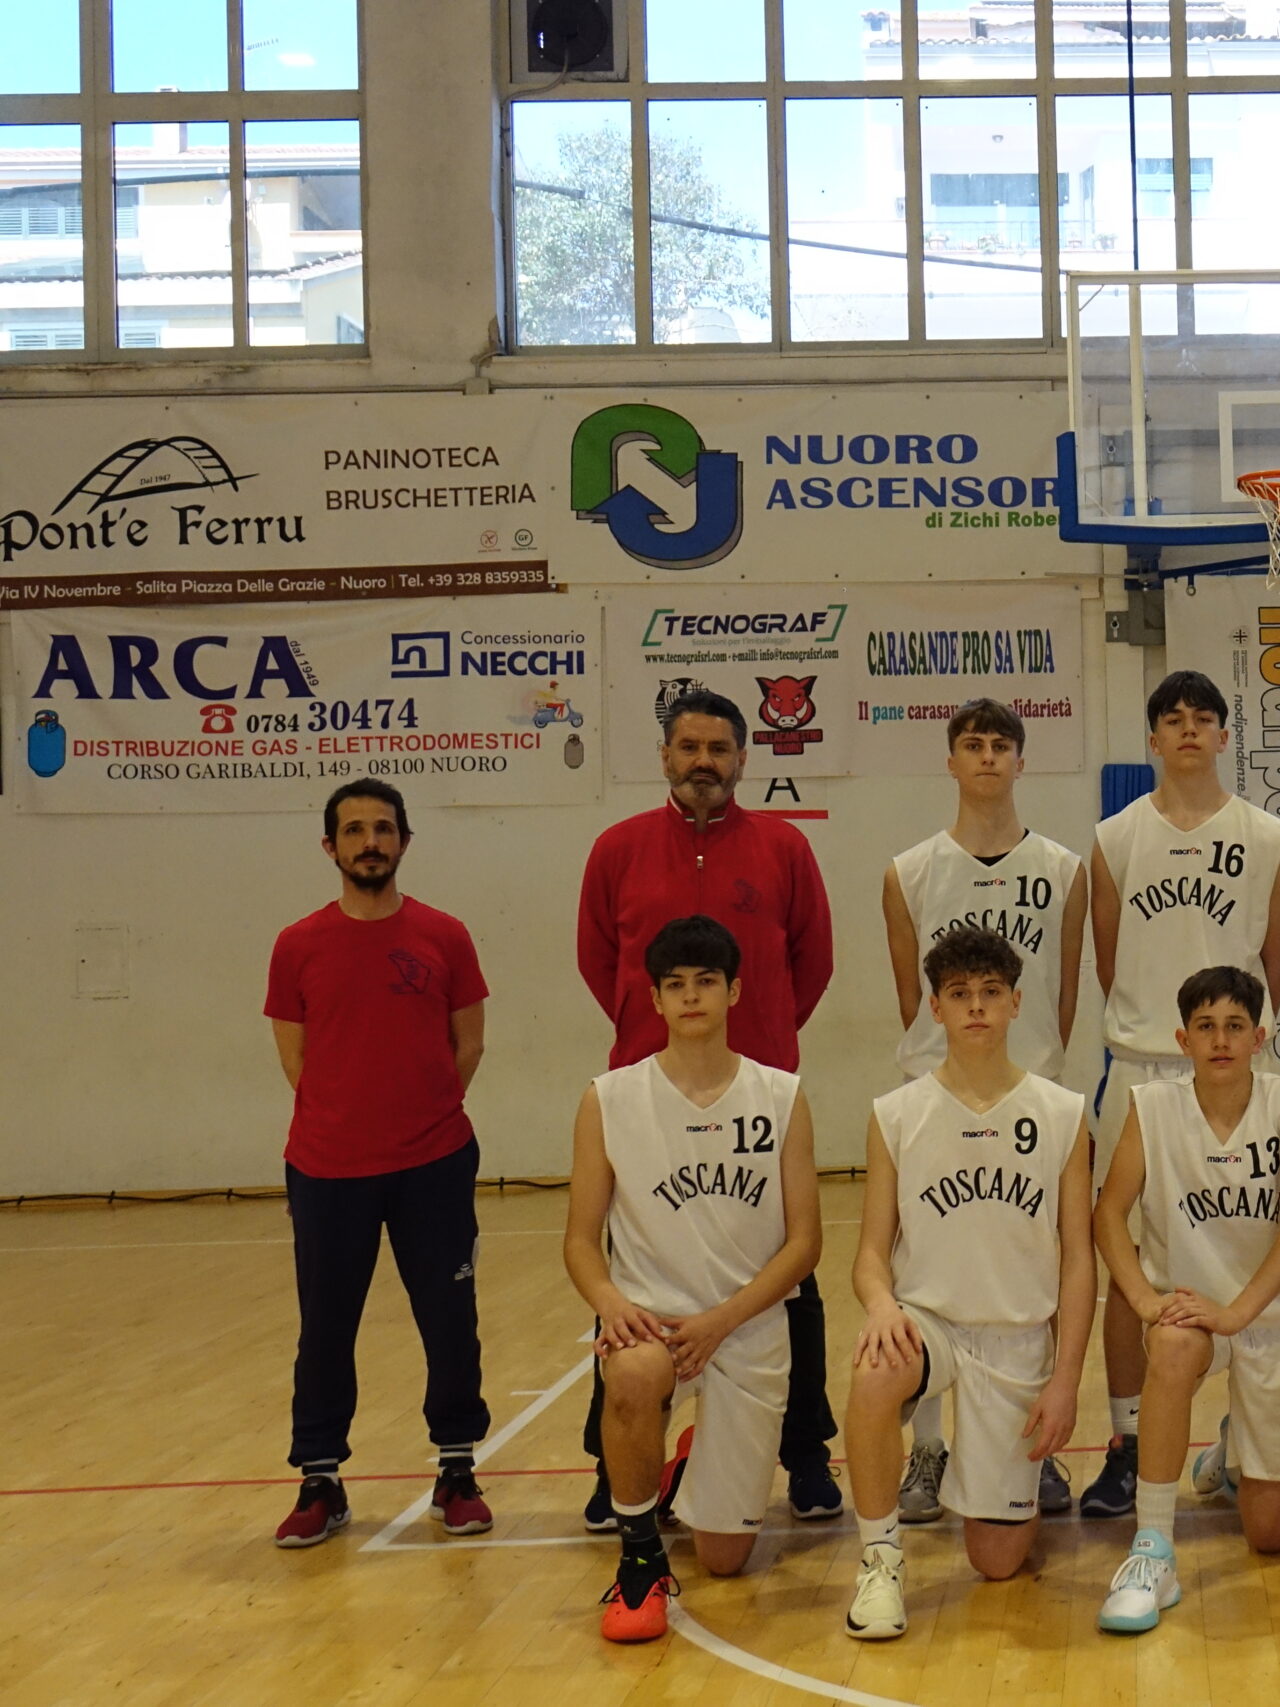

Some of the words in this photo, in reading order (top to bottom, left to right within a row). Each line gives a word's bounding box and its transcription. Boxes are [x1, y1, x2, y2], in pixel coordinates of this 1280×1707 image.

[324, 446, 500, 471] PANINOTECA
[766, 434, 979, 465] NUORO
[326, 483, 536, 510] BRUSCHETTERIA
[766, 476, 1060, 510] ASCENSOR
[171, 504, 306, 546] Ferru
[925, 512, 943, 528] di
[950, 512, 1000, 528] Zichi
[1008, 511, 1060, 528] Robe
[24, 585, 40, 599] IV
[44, 583, 121, 598] Novembre
[136, 580, 177, 595] Salita
[182, 579, 233, 593] Piazza
[237, 578, 274, 592] Delle
[278, 577, 325, 591] Grazie
[340, 575, 387, 589] Nuoro
[399, 573, 424, 587] Tel.
[428, 573, 452, 586] +39
[456, 572, 481, 585] 328
[485, 570, 544, 584] 8359335
[461, 630, 585, 645] Concessionario
[664, 612, 828, 636] TECNOGRAF
[31, 634, 317, 700] ARCA
[289, 639, 305, 658] dal
[299, 659, 319, 687] 1949
[461, 650, 585, 676] NECCHI
[867, 630, 959, 676] CARASANDE
[962, 630, 991, 675] PRO
[994, 629, 1014, 674] SA
[1017, 628, 1055, 674] VIDA
[246, 713, 299, 733] 0784
[307, 697, 419, 732] 30474
[858, 700, 869, 721] Il
[872, 703, 904, 724] pane
[73, 739, 244, 757] DISTRIBUZIONE
[252, 738, 298, 755] GAS
[319, 732, 541, 754] ELETTRODOMESTICI
[1232, 694, 1249, 792] nodipendenze
[107, 763, 180, 780] CORSO
[186, 761, 311, 780] GARIBALDI,
[317, 760, 350, 777] 149
[369, 758, 425, 774] 08100
[431, 756, 507, 773] NUORO
[1170, 847, 1202, 856] macron
[1208, 841, 1245, 878] 16
[973, 878, 1006, 887] macron
[1015, 875, 1052, 910] 10
[1129, 876, 1236, 926] TOSCANA
[686, 1123, 722, 1132] macron
[732, 1115, 774, 1154] 12
[962, 1128, 998, 1138] macron
[1014, 1117, 1038, 1154] 9
[1207, 1154, 1241, 1164] macron
[1246, 1136, 1280, 1179] 13
[652, 1163, 768, 1211] TOSCANA
[919, 1166, 1045, 1218] TOSCANA
